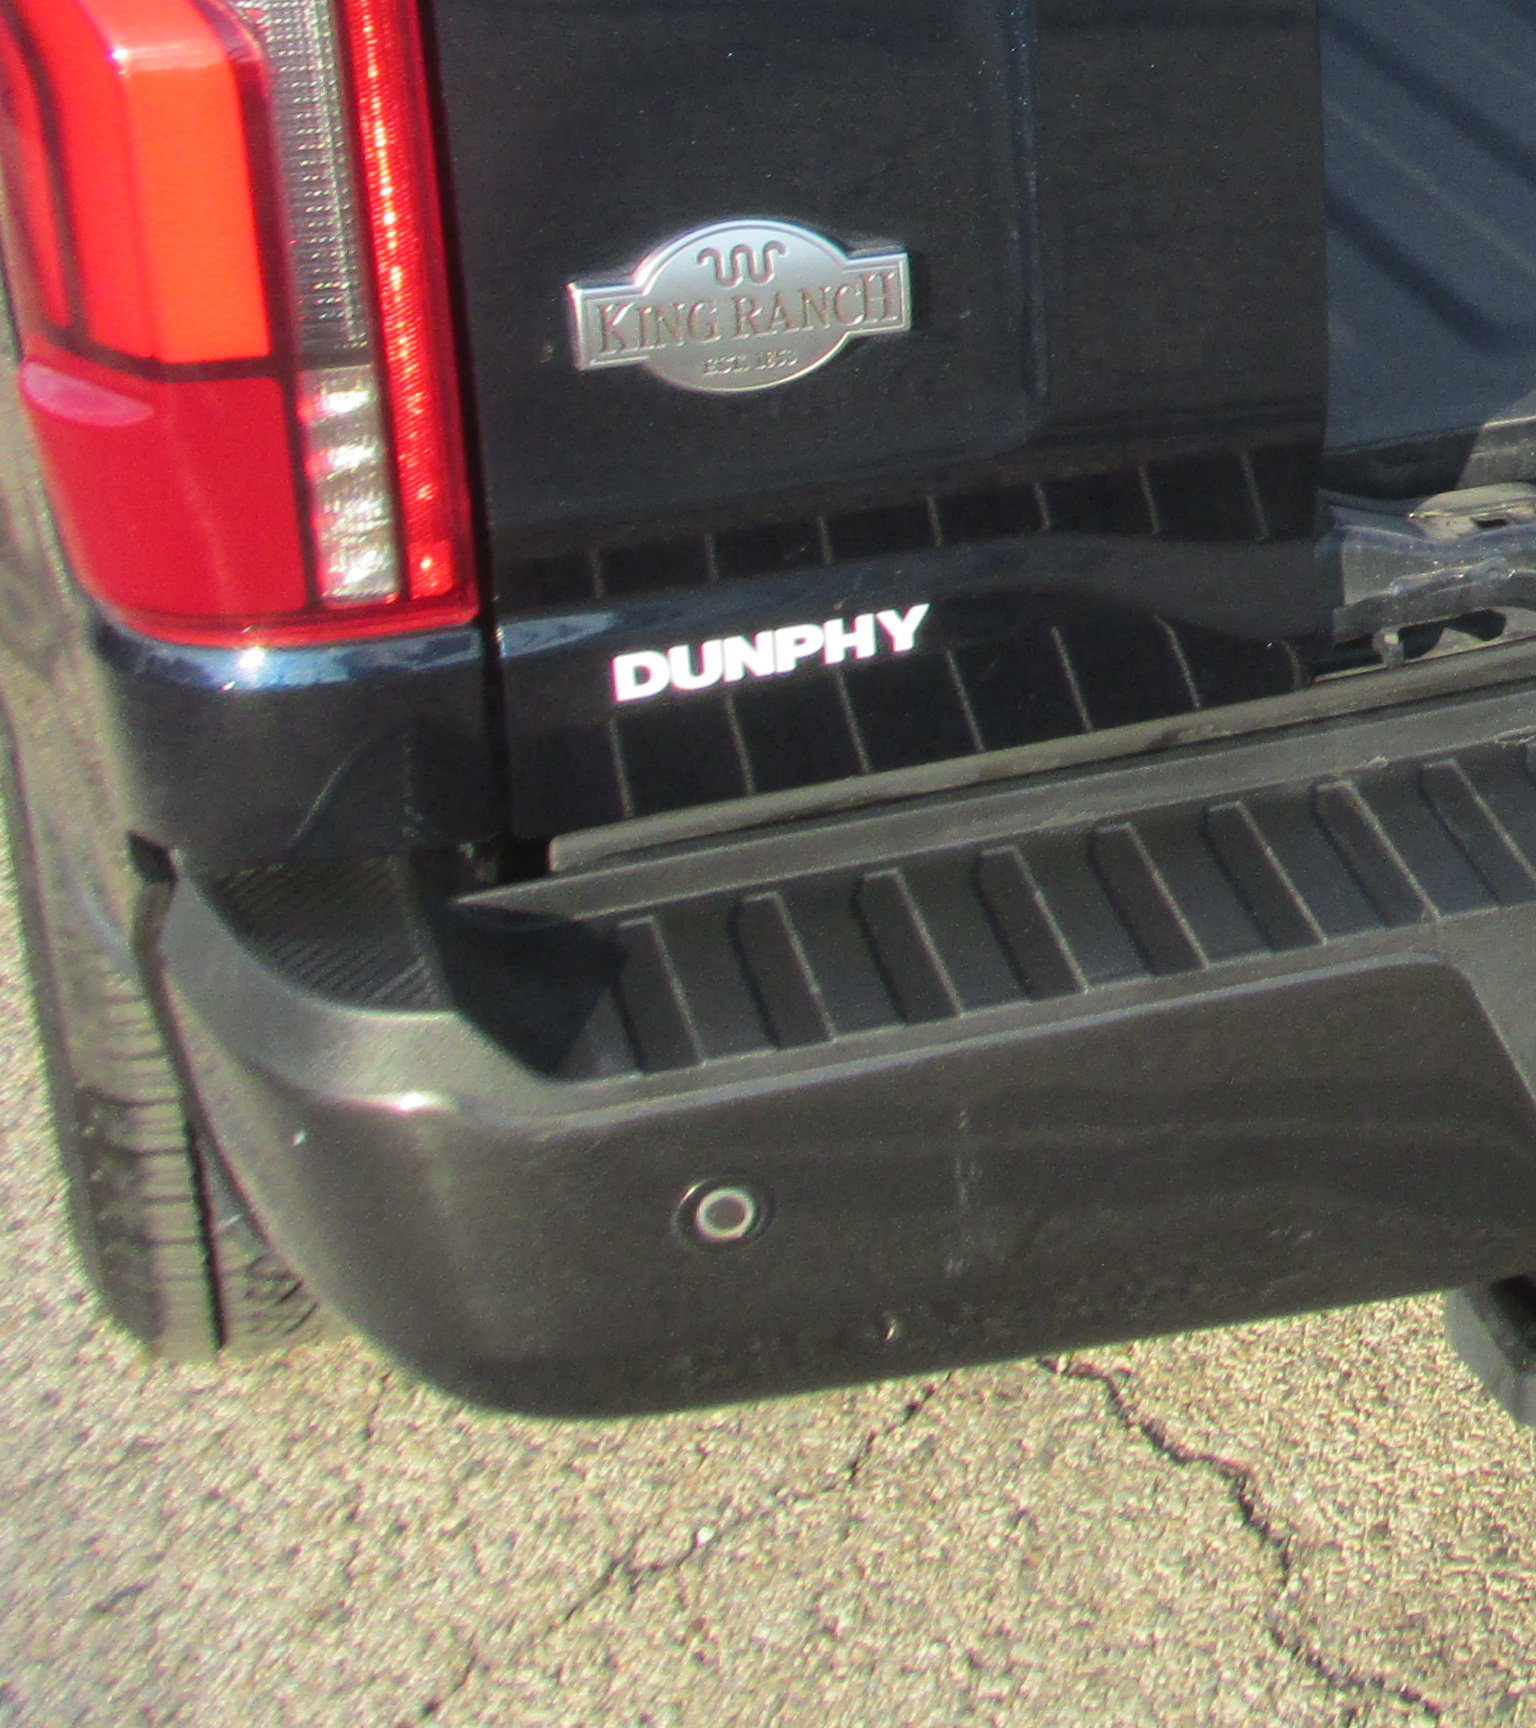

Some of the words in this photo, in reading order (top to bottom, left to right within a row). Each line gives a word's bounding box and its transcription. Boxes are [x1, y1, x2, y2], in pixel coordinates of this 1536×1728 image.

[597, 299, 722, 356] KING
[731, 270, 899, 340] RANCH
[610, 602, 931, 703] DUNPHY
